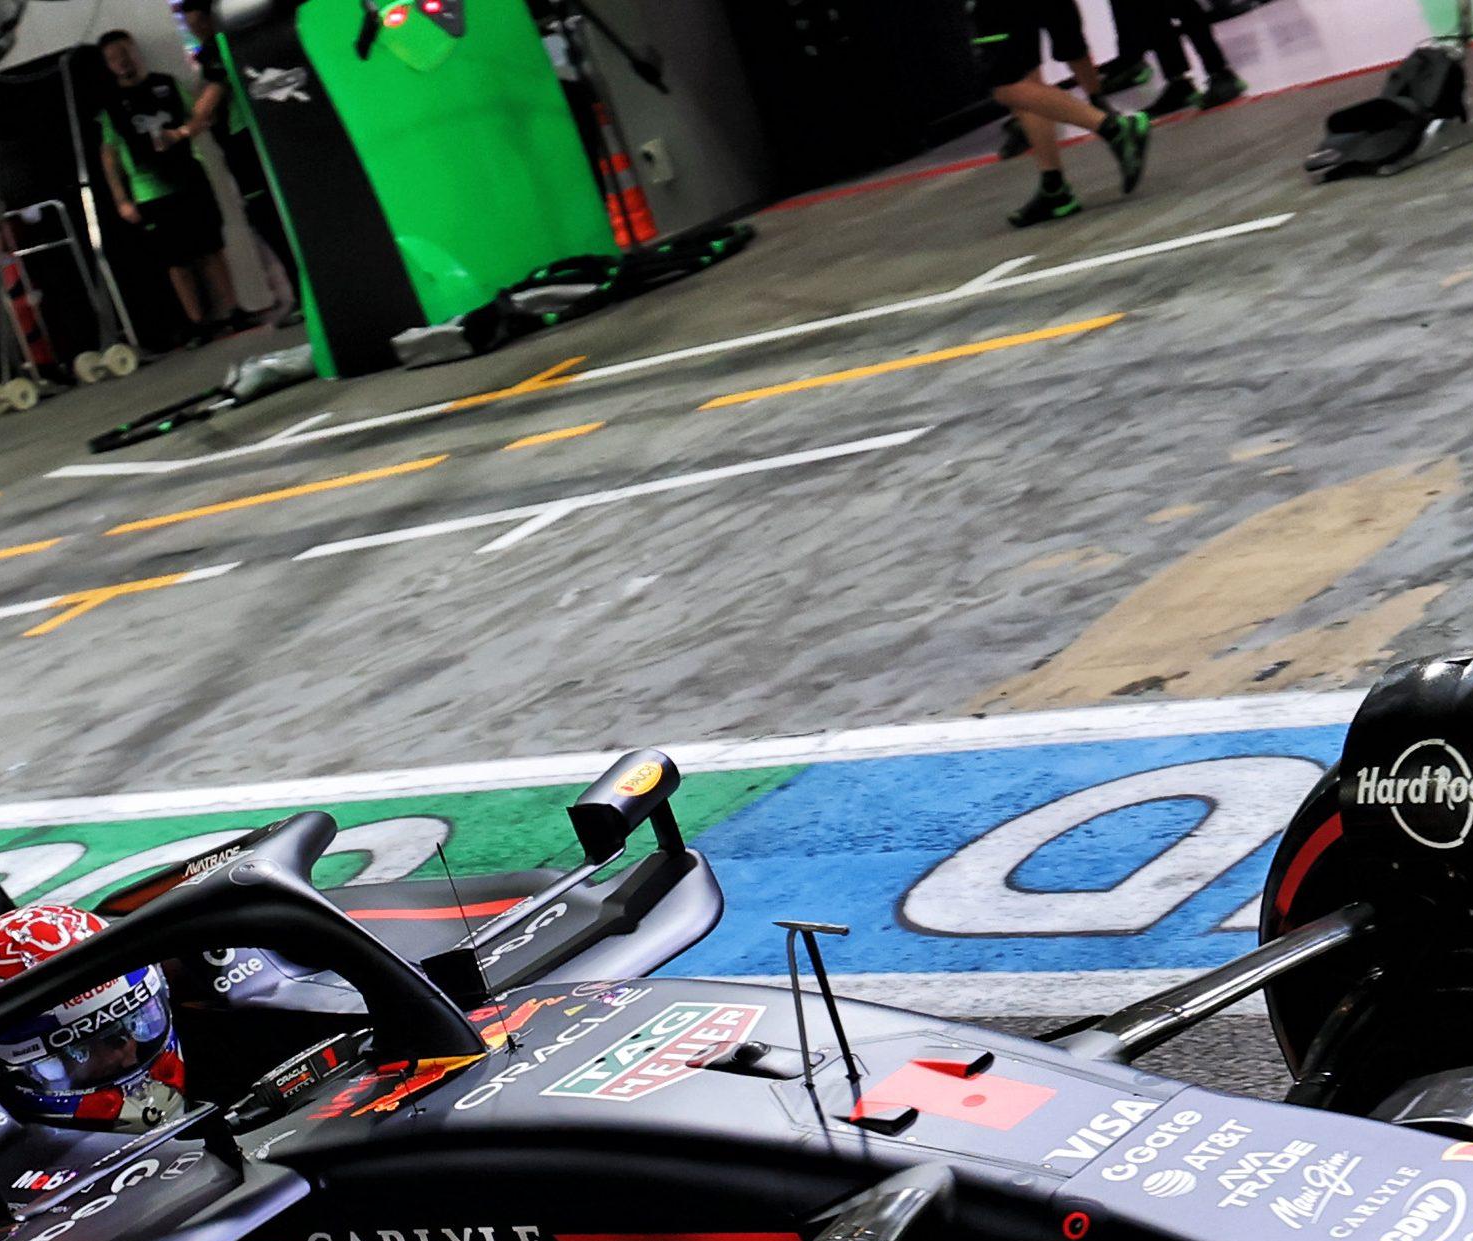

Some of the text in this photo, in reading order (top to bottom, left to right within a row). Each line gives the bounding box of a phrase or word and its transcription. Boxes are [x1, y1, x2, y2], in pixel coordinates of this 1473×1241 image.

[1356, 766, 1428, 806] Hard
[213, 955, 264, 994] Gate
[49, 983, 150, 1047] ORACLE
[454, 986, 654, 1111] ORACLE
[564, 1011, 702, 1088] TAG
[609, 1010, 747, 1095] HEUER
[1043, 1099, 1161, 1163] VISA
[1124, 1110, 1203, 1164] Gate
[1182, 1119, 1254, 1171] AT&T
[1217, 1151, 1275, 1190] AVA
[1217, 1139, 1318, 1208] TRADE
[1269, 1150, 1356, 1229] Maui Jim
[1329, 1166, 1422, 1239] CARLYLE
